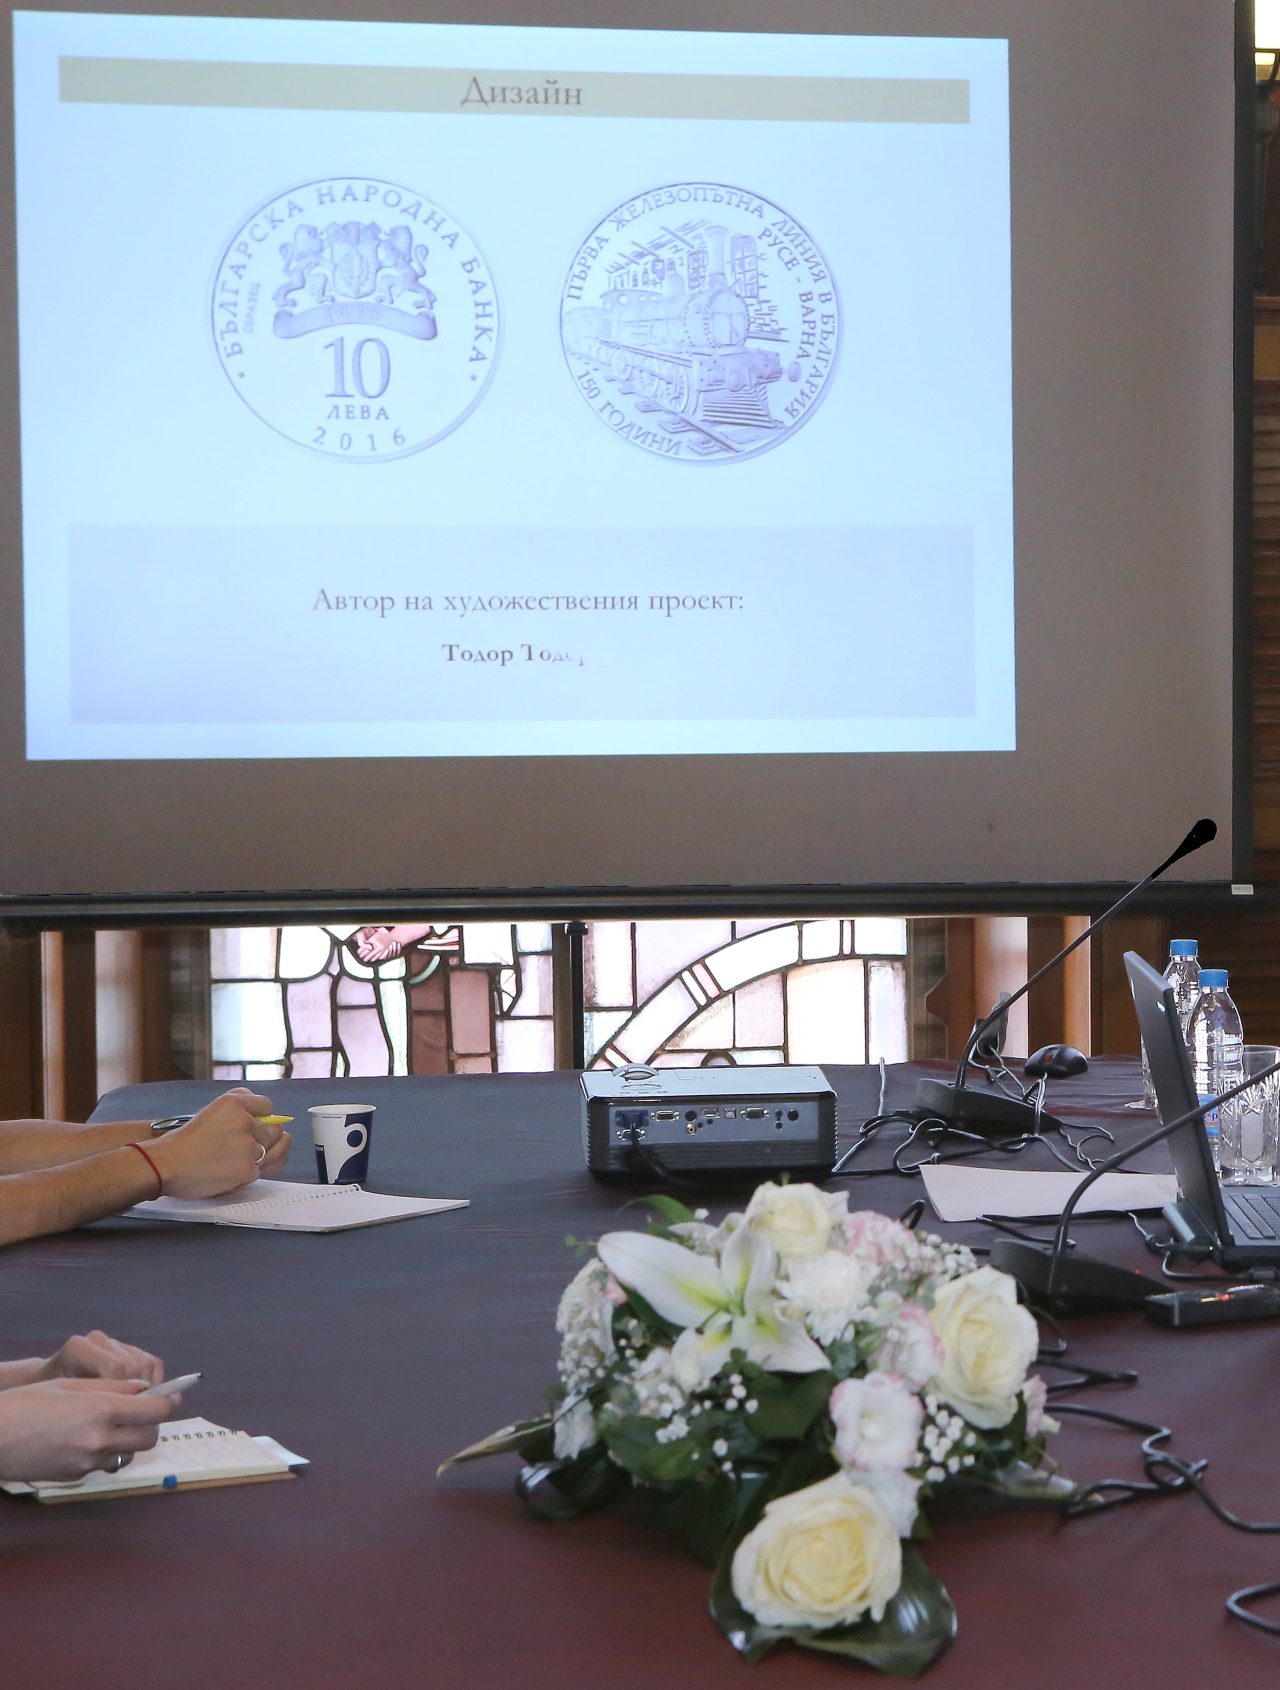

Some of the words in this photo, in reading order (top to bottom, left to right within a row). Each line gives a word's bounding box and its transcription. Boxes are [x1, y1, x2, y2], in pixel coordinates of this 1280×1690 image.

[460, 76, 583, 107] Дизайн
[609, 187, 765, 232] ЖЕЛЕЗОПЪТНА
[219, 199, 304, 359] БЪЛГАРСКА
[316, 185, 462, 249] НАРОДНА
[461, 256, 493, 363] БАНКА
[567, 235, 608, 301] ПЪРВА
[771, 219, 827, 284] ЛИНИЯ
[758, 227, 800, 271] РУСЕ
[796, 291, 816, 360] ВАРНА
[818, 291, 833, 304] В
[323, 336, 391, 399] 10
[784, 312, 835, 419] БЪЛГАРИЯ
[327, 404, 390, 420] ЛЕВА
[577, 370, 601, 400] 150
[598, 401, 683, 456] ГОДИНИ
[312, 588, 395, 618] Автор
[404, 594, 433, 610] на
[444, 593, 638, 618] художествения
[649, 594, 744, 618] проект:
[442, 643, 514, 667] Тодор
